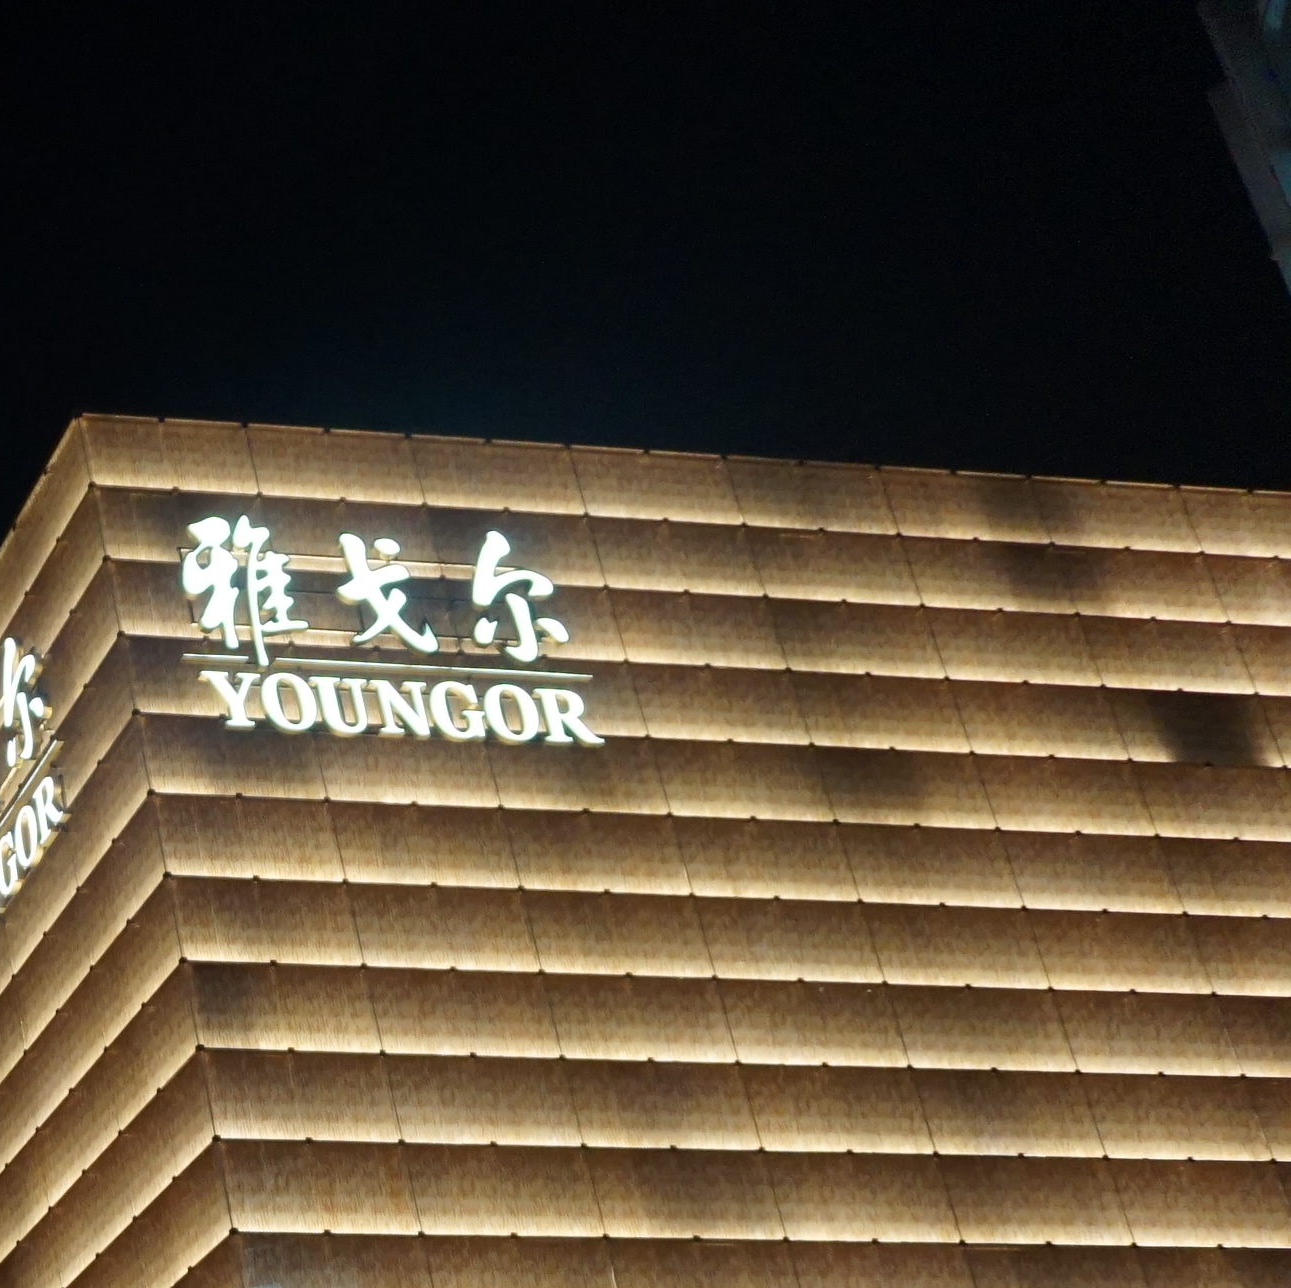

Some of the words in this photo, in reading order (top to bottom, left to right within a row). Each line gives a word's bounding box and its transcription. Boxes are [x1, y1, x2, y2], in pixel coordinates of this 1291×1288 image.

[181, 514, 569, 666] 雅戈尔
[199, 669, 605, 747] YOUNGOR
